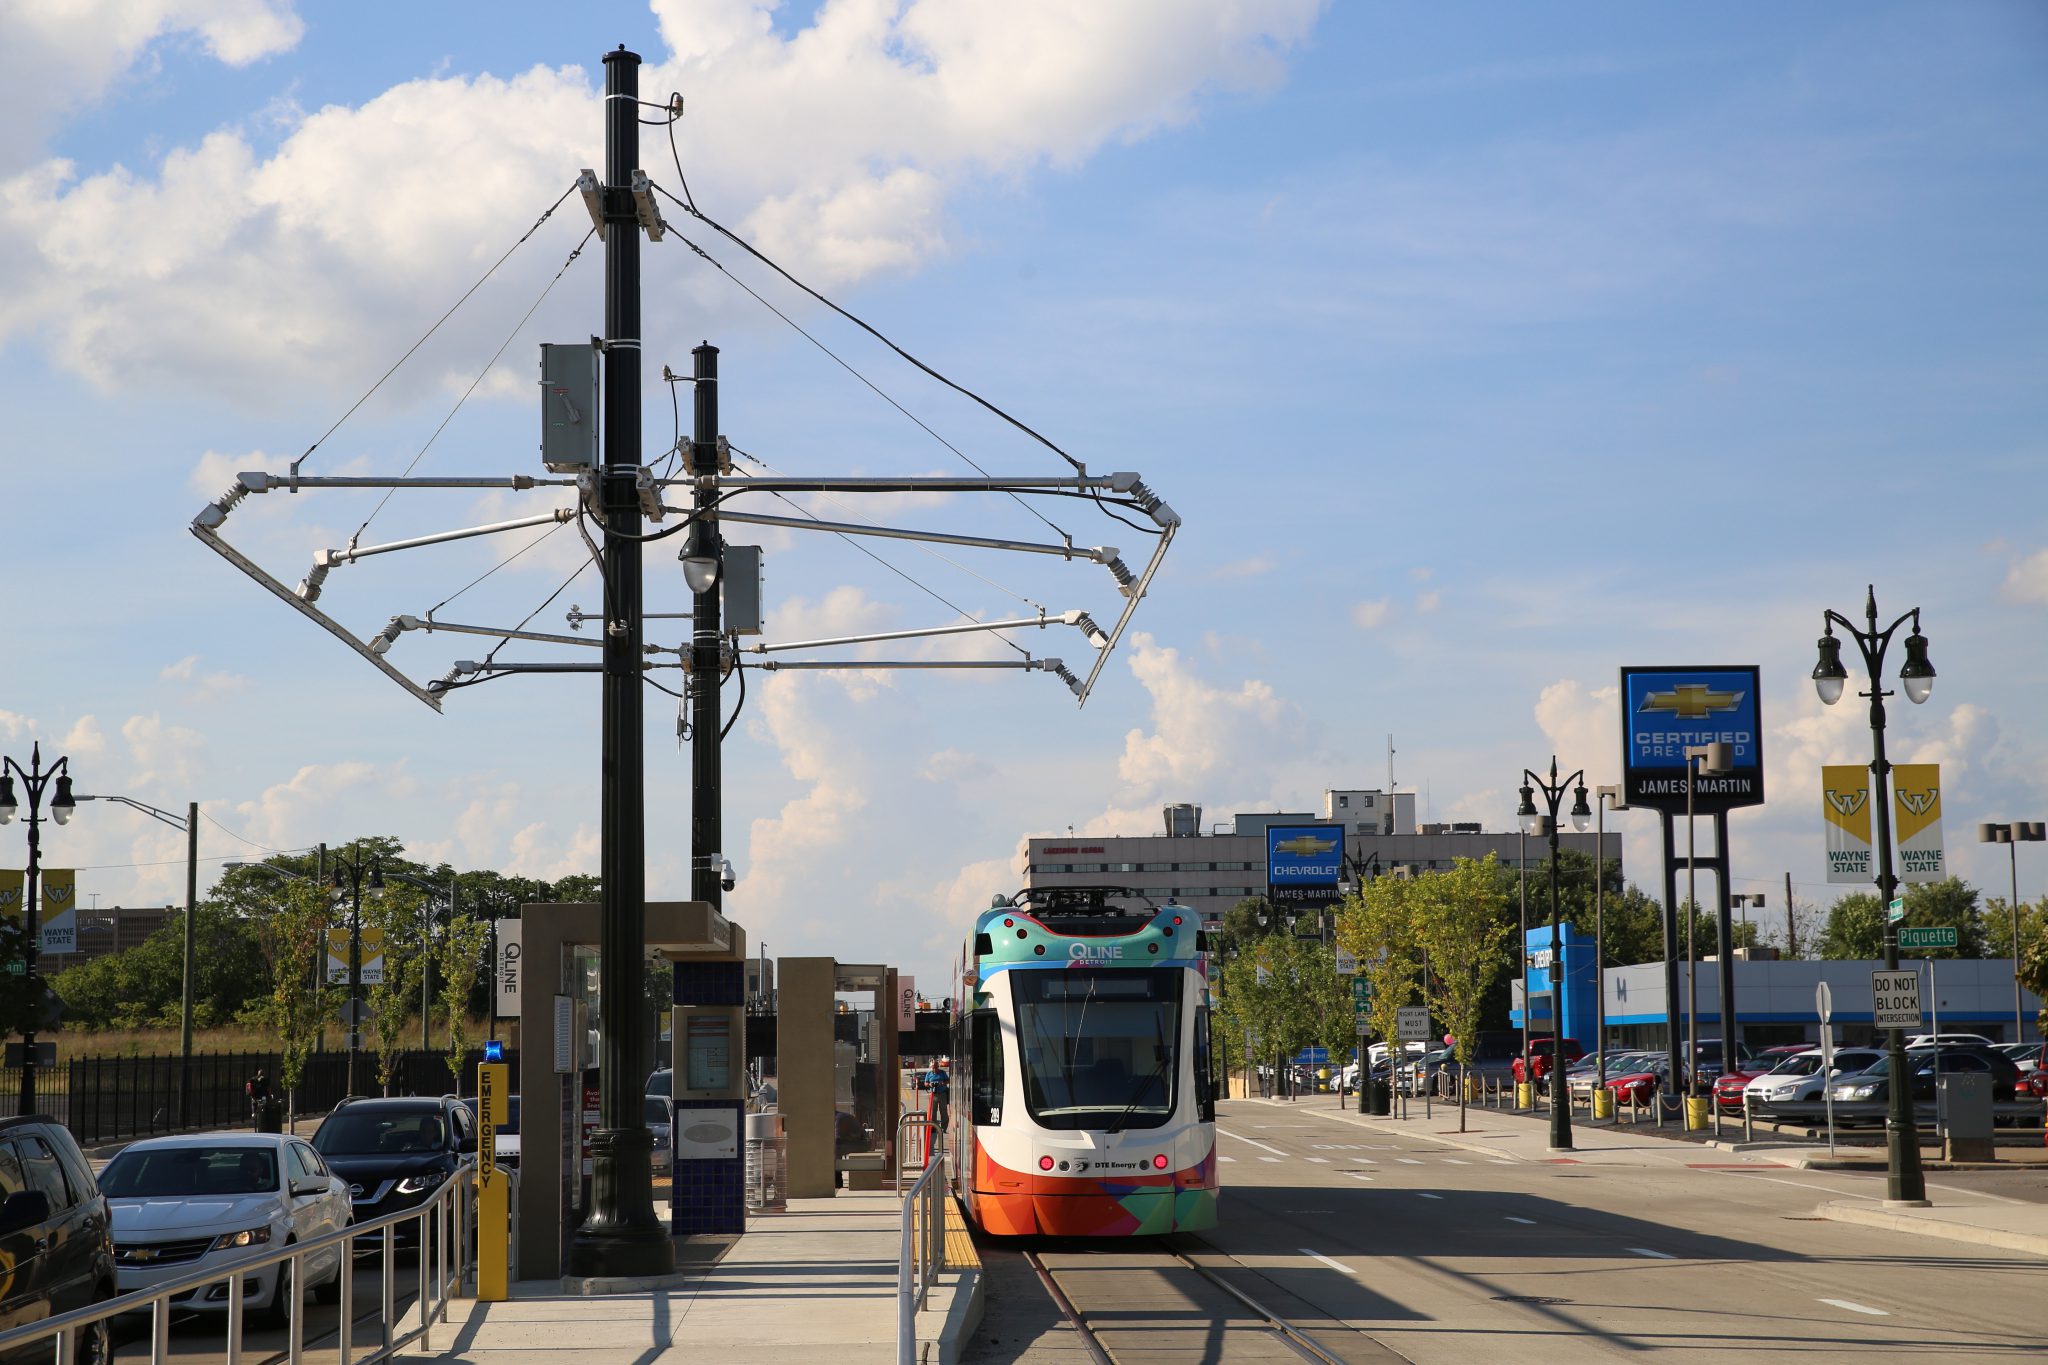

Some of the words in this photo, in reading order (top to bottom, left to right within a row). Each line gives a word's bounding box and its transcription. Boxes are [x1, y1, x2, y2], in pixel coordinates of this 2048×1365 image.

[1636, 732, 1750, 744] CERTIFIED
[1642, 745, 1745, 757] PRE-D
[1828, 851, 1871, 861] WAYNE
[1900, 850, 1943, 861] WAYNE
[1274, 866, 1340, 875] CHEVROLET
[1834, 862, 1867, 873] STATE
[1906, 861, 1940, 872] STATE
[43, 927, 75, 937] WAYNE
[1900, 929, 1954, 946] Piquette
[47, 936, 72, 945] STATE
[1068, 942, 1123, 960] QLINE
[504, 942, 521, 994] QLINE
[1875, 978, 1890, 991] DO
[1894, 978, 1916, 991] NOT
[903, 988, 914, 1018] QLINE
[1876, 996, 1918, 1010] BLOCK
[1877, 1013, 1920, 1023] INTERSECTION
[990, 1107, 1000, 1124] 289
[481, 1071, 492, 1188] EMERGENCY
